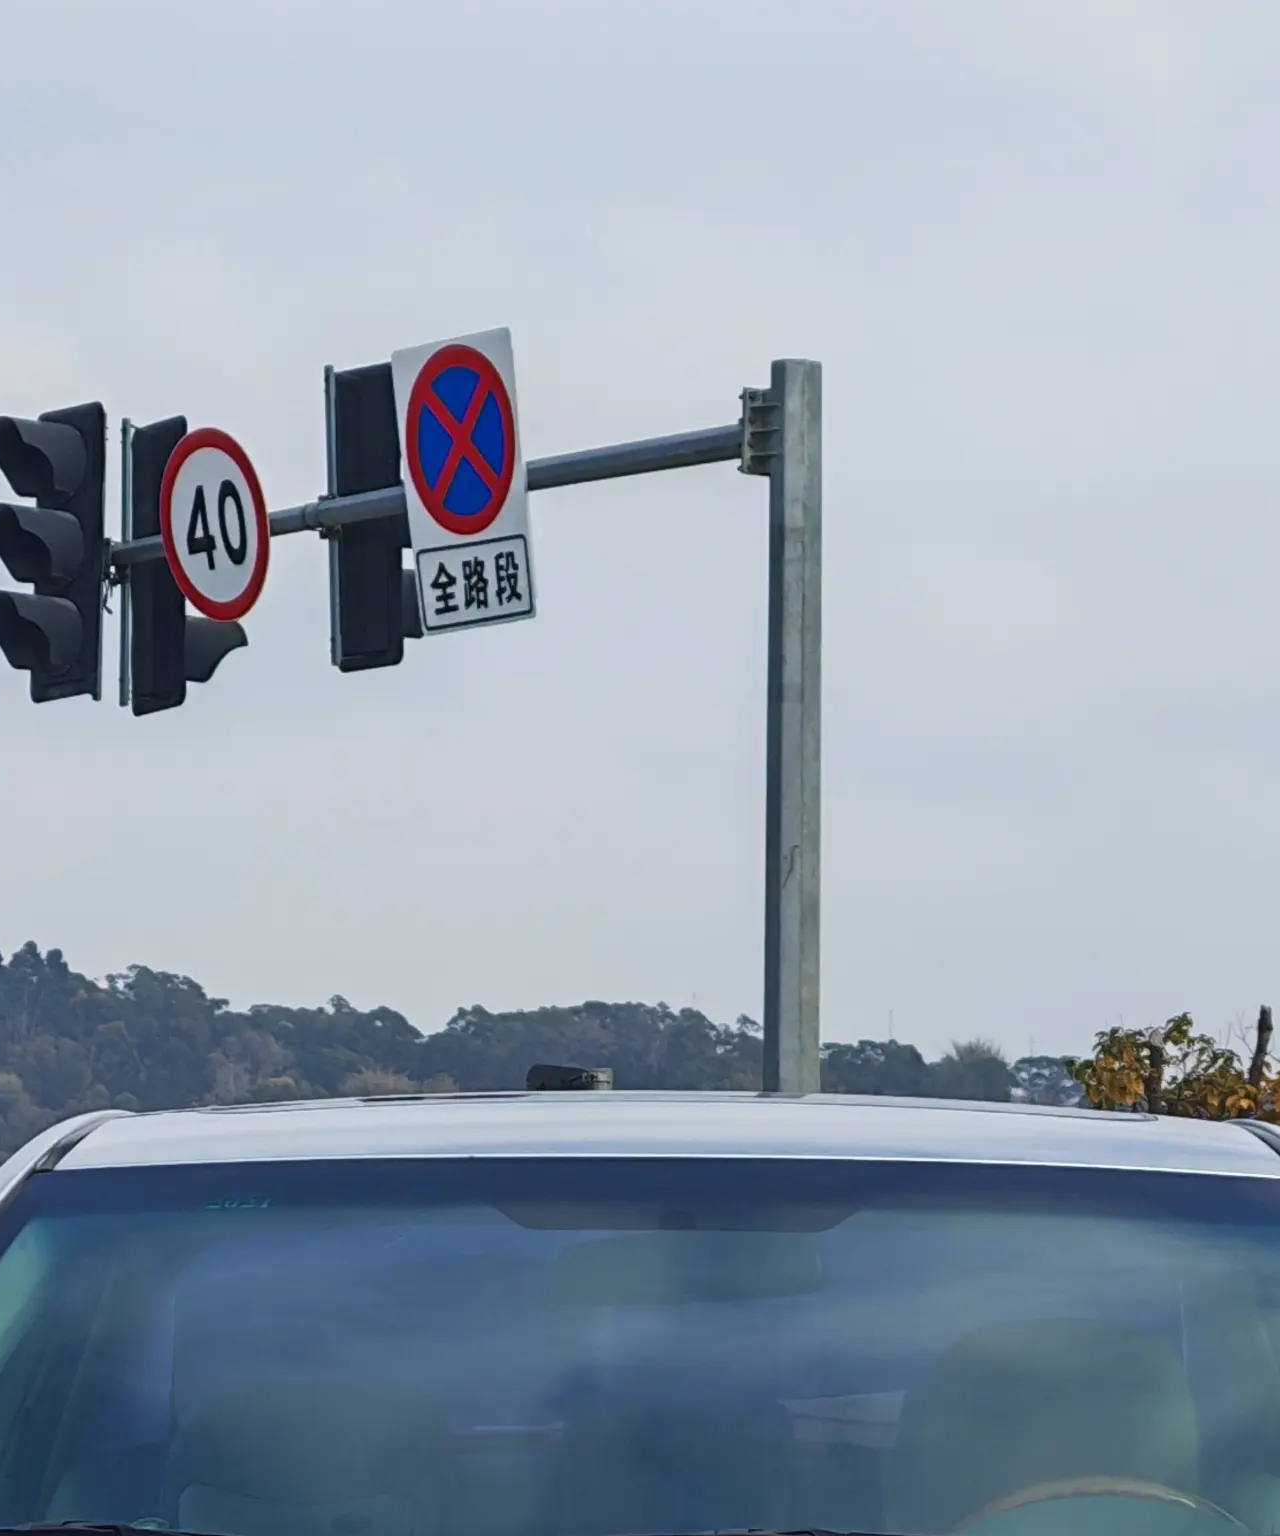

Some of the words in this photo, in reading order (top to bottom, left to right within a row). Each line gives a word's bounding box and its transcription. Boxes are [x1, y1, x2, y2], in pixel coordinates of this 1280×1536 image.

[187, 479, 247, 570] 40
[430, 551, 522, 615] 全路段
